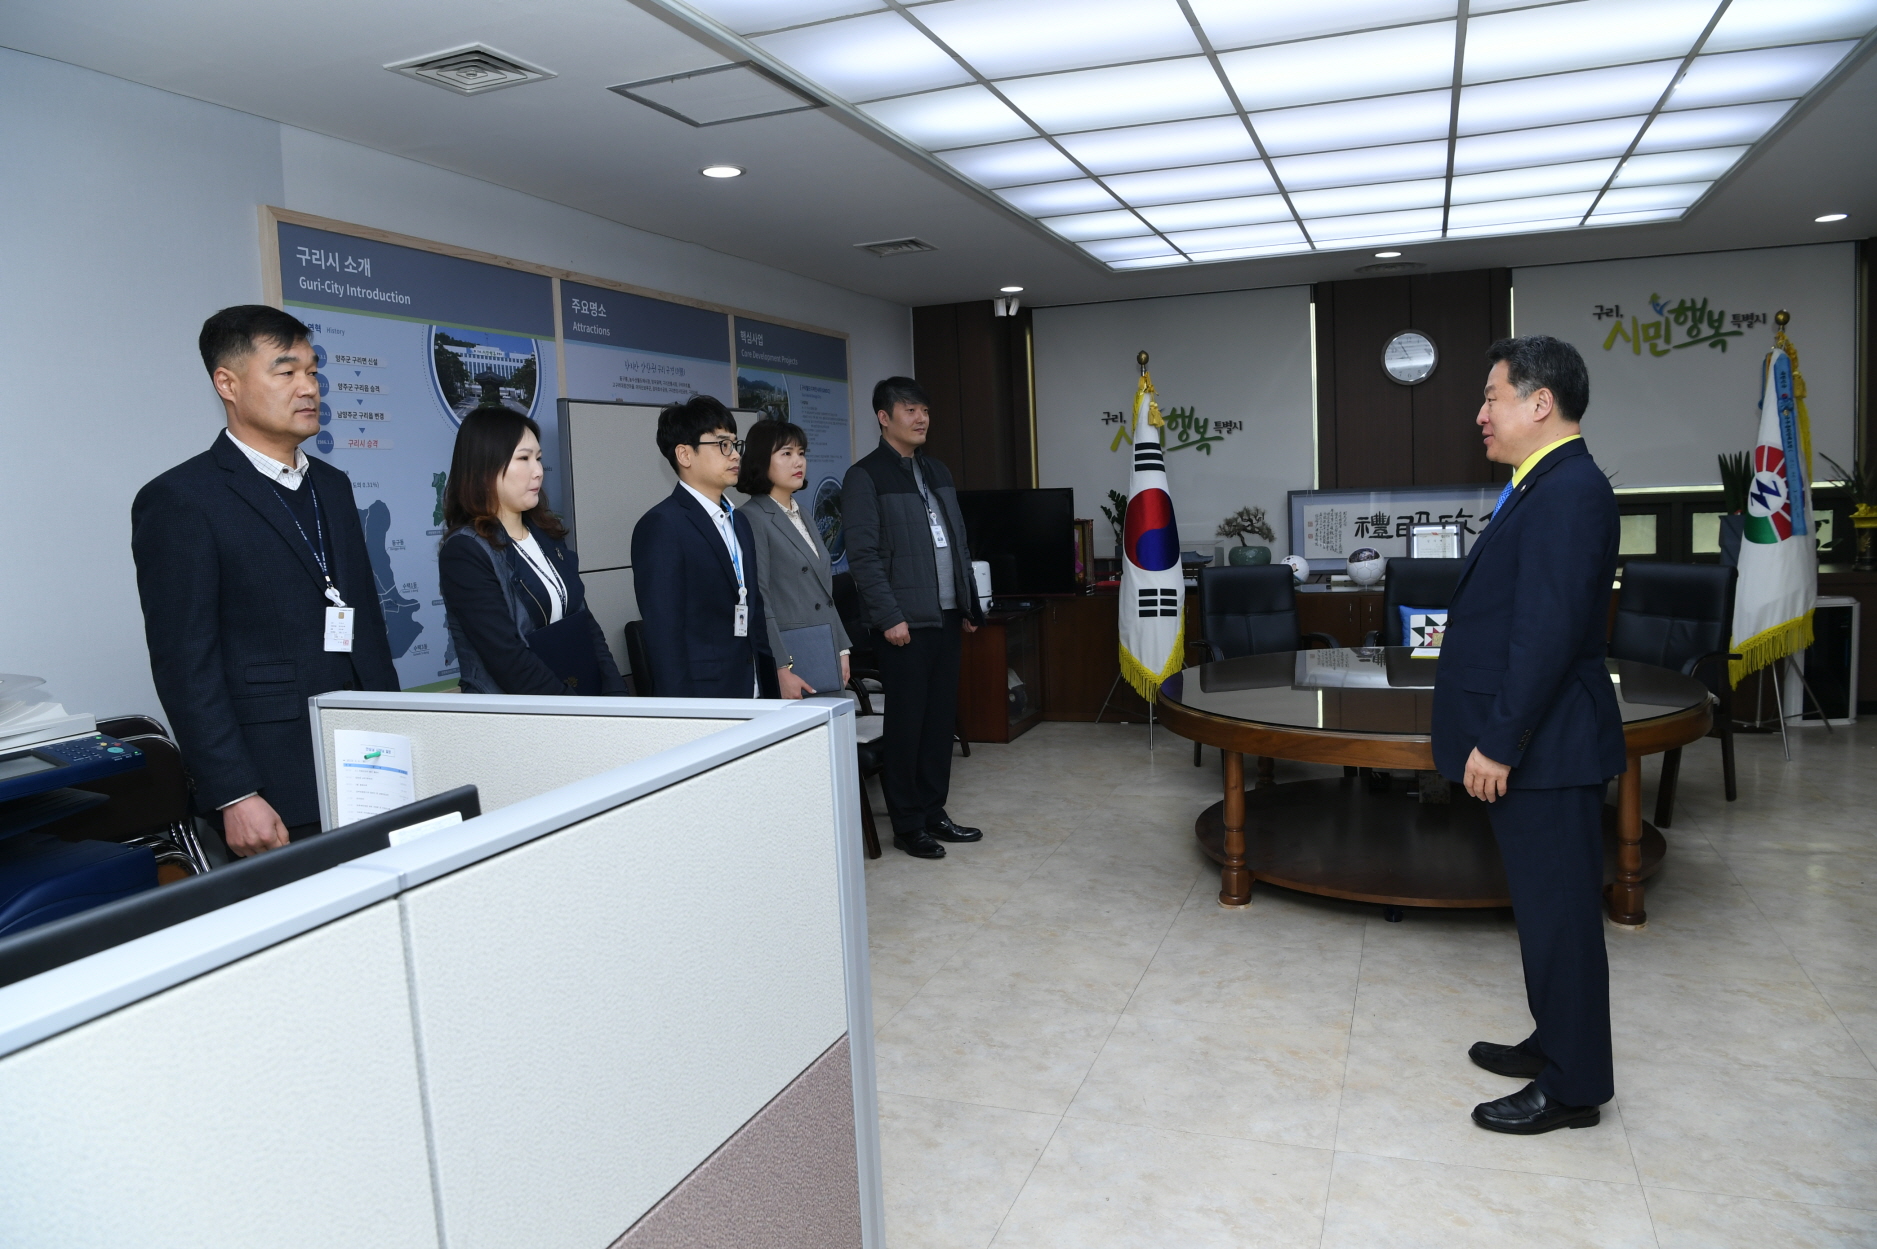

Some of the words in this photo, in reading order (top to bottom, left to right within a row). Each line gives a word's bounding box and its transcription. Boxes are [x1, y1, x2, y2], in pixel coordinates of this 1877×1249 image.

[296, 246, 340, 272] 구리시
[344, 257, 371, 278] 소개
[299, 277, 344, 297] Guri-City
[346, 284, 411, 305] Introduction
[571, 298, 607, 318] 주요명소
[1593, 305, 1624, 320] 구리,
[1731, 313, 1766, 328] 특별시
[327, 327, 345, 336] History
[573, 321, 610, 337] Attractions
[740, 330, 763, 346] 핵심사업
[741, 349, 752, 358] Core
[753, 350, 781, 362] Development
[781, 355, 798, 366] Projects
[1101, 411, 1126, 425] 구리,
[1213, 420, 1243, 434] 특별시
[348, 439, 365, 448] 구리시
